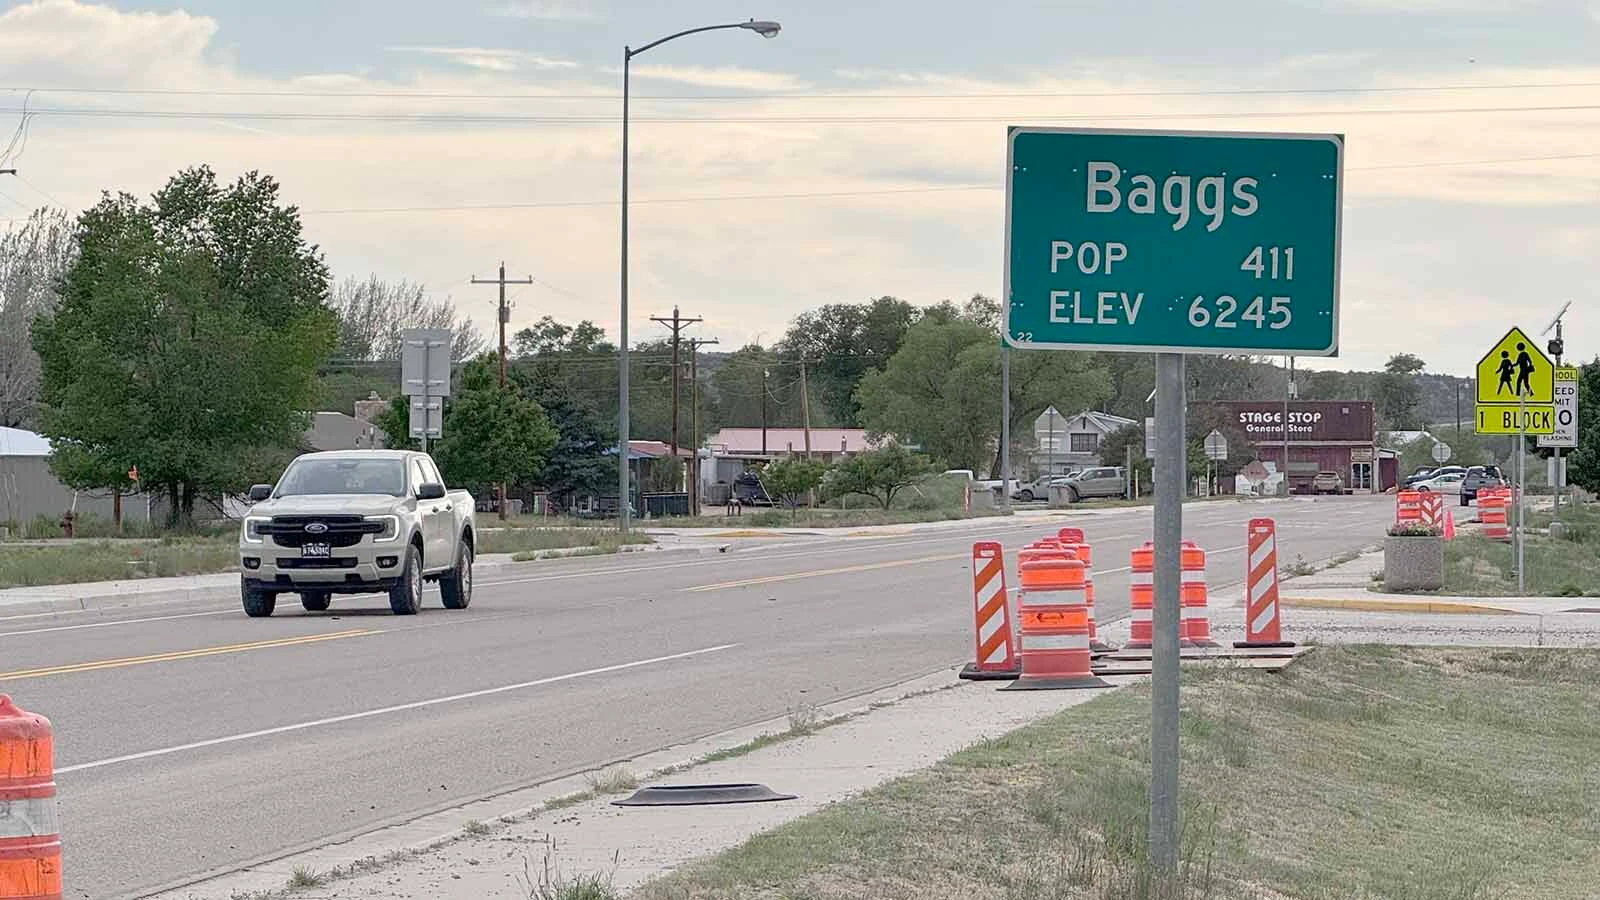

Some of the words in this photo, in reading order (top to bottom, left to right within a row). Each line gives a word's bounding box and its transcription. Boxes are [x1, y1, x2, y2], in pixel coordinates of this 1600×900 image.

[1086, 161, 1259, 232] Baggs
[1050, 240, 1128, 275] POP
[1240, 246, 1294, 280] 411
[1049, 291, 1144, 325] ELEV
[1188, 295, 1292, 329] 6245
[1017, 331, 1033, 343] 22
[1555, 371, 1575, 379] OOL
[1555, 387, 1575, 395] EED
[1555, 398, 1570, 406] MIT
[1239, 412, 1281, 423] STAGE
[1288, 412, 1322, 423] STOP
[1480, 411, 1484, 429] 1
[1503, 411, 1550, 429] BLOCK
[1559, 410, 1572, 425] 0
[1246, 424, 1284, 432] General
[1288, 424, 1313, 432] Store
